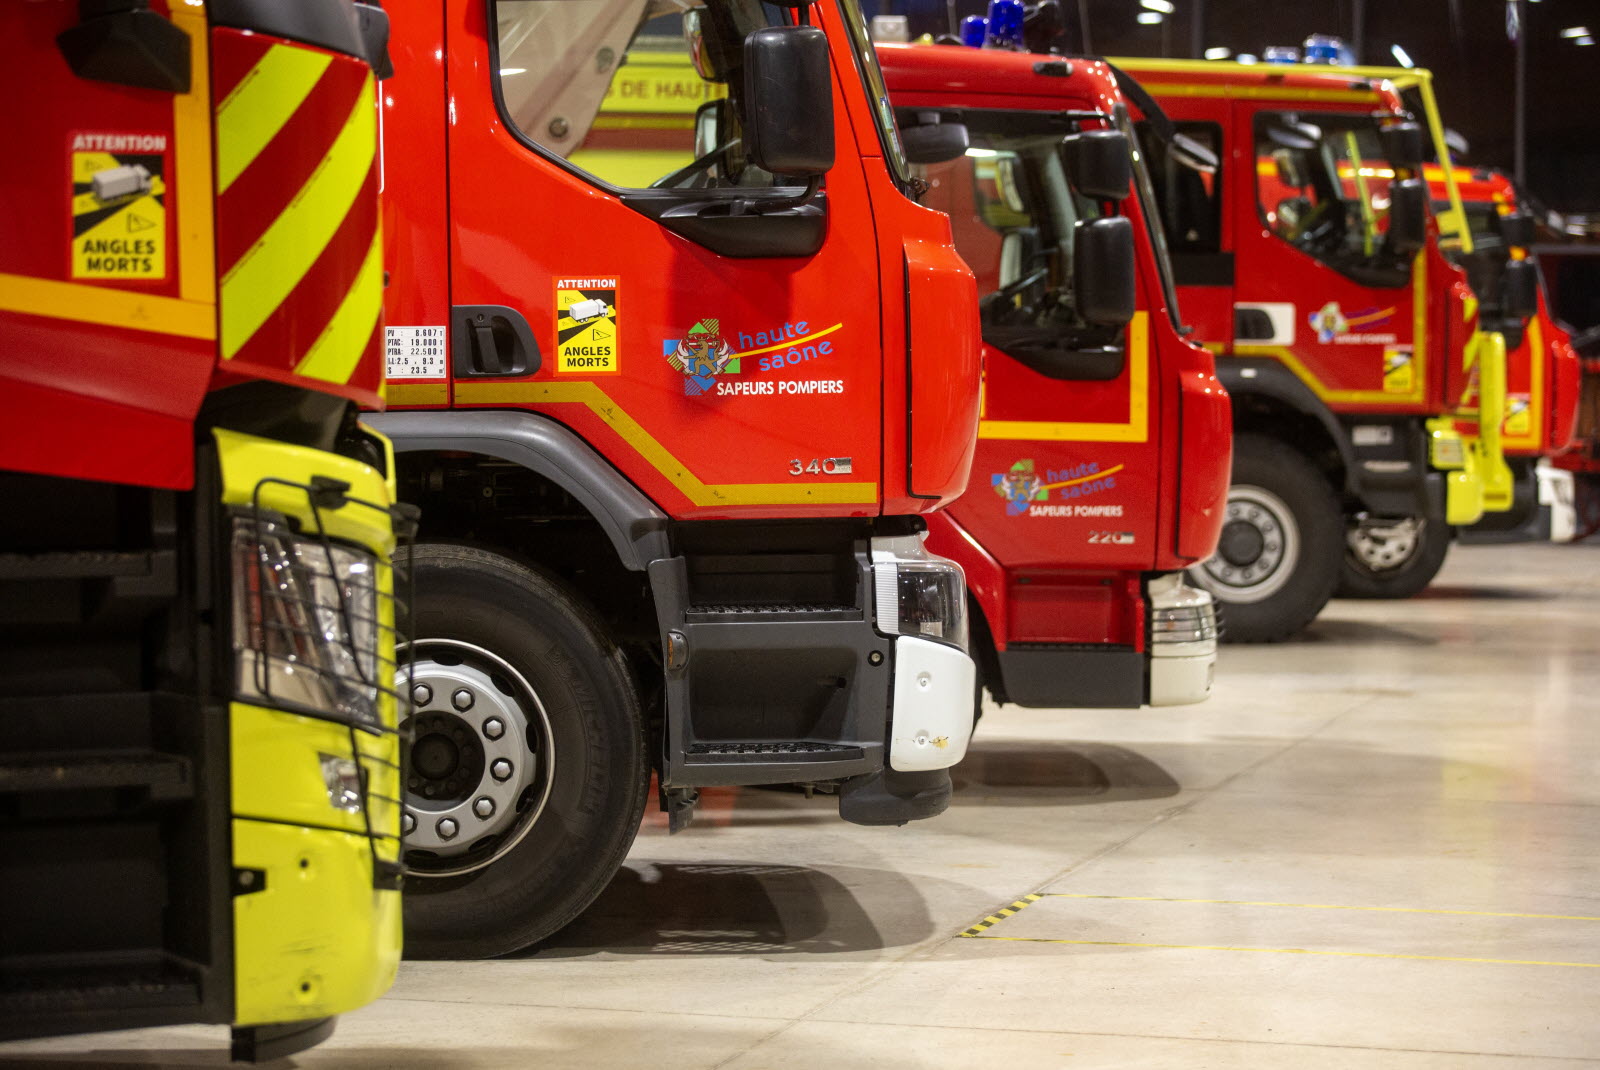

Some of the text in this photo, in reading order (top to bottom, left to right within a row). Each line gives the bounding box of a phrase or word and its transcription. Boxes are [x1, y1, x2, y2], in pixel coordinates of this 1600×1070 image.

[621, 80, 649, 98] DE
[73, 134, 167, 151] ATTENTION
[83, 239, 156, 255] ANGLES
[87, 257, 152, 272] MORTS
[557, 279, 616, 289] ATTENTION
[415, 329, 437, 337] 8.607
[738, 321, 810, 349] haute
[411, 339, 437, 347] 19.000
[410, 348, 437, 356] 22.500
[564, 346, 611, 357] ANGLES
[758, 341, 834, 372] saône
[567, 357, 609, 368] MORTS
[410, 367, 427, 375] 23.5
[716, 380, 844, 396] SAPEURS POMPIERS
[789, 458, 837, 475] 340
[1046, 462, 1100, 483] haute
[1029, 505, 1123, 517] SAPEURS POMPIERS
